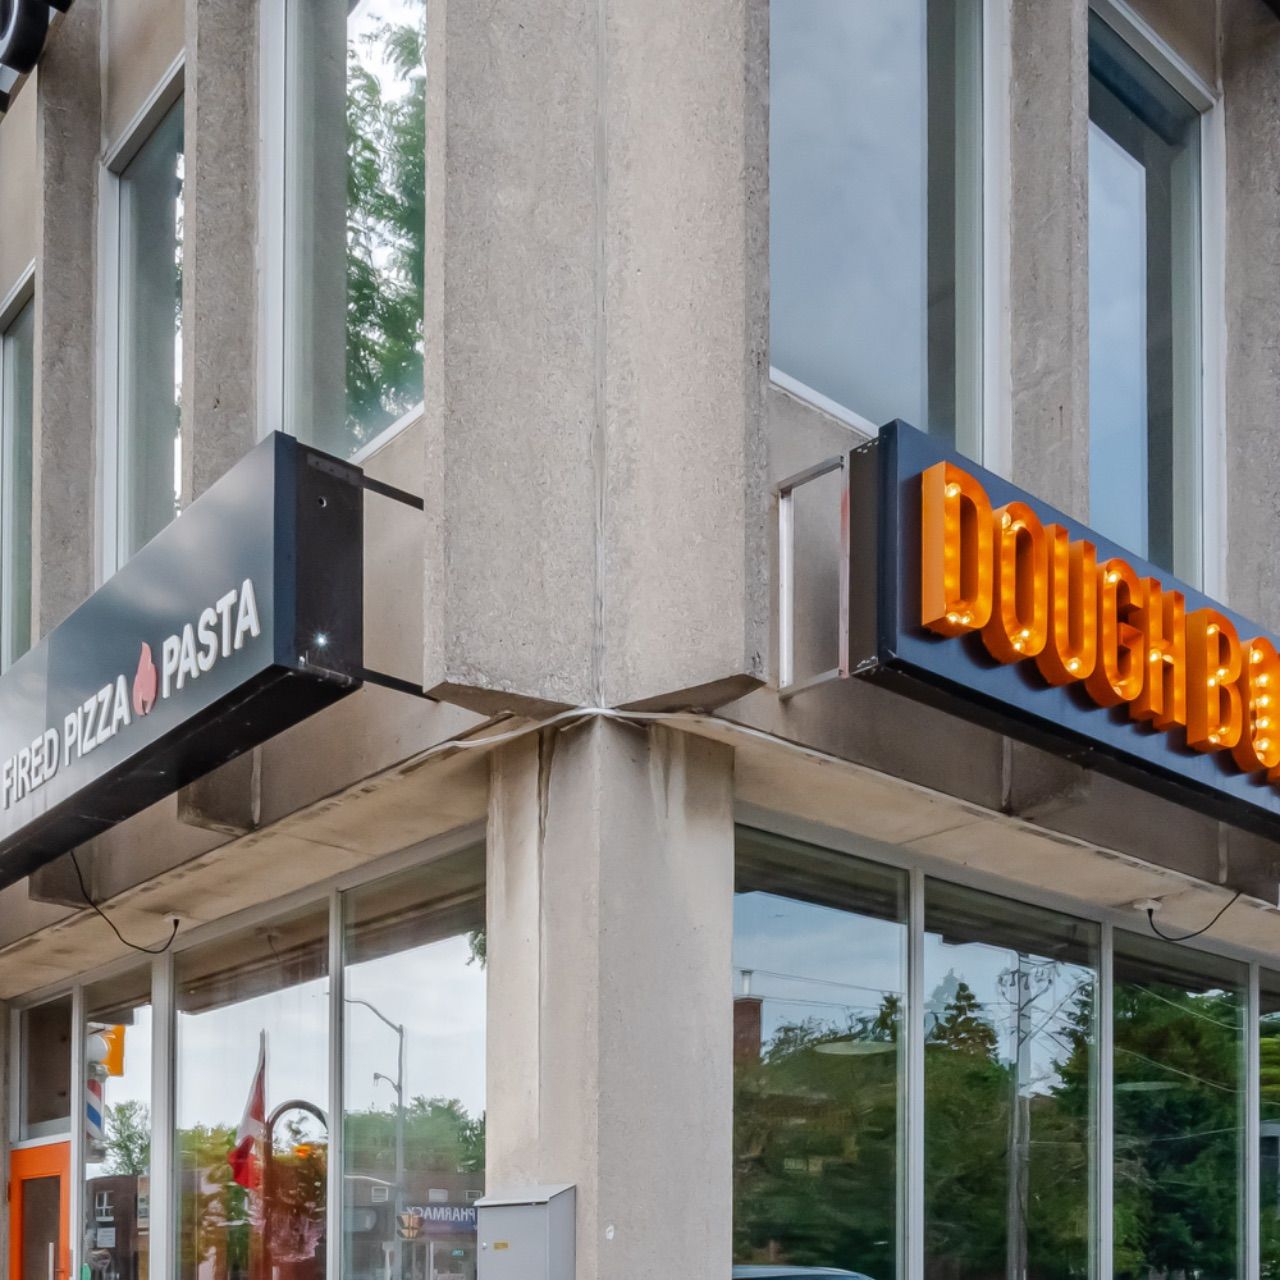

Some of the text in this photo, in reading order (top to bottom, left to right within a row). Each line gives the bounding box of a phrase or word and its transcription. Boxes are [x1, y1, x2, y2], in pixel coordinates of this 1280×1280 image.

[3, 728, 59, 810] FIRED
[64, 674, 131, 767] PIZZA
[162, 578, 261, 699] PASTA
